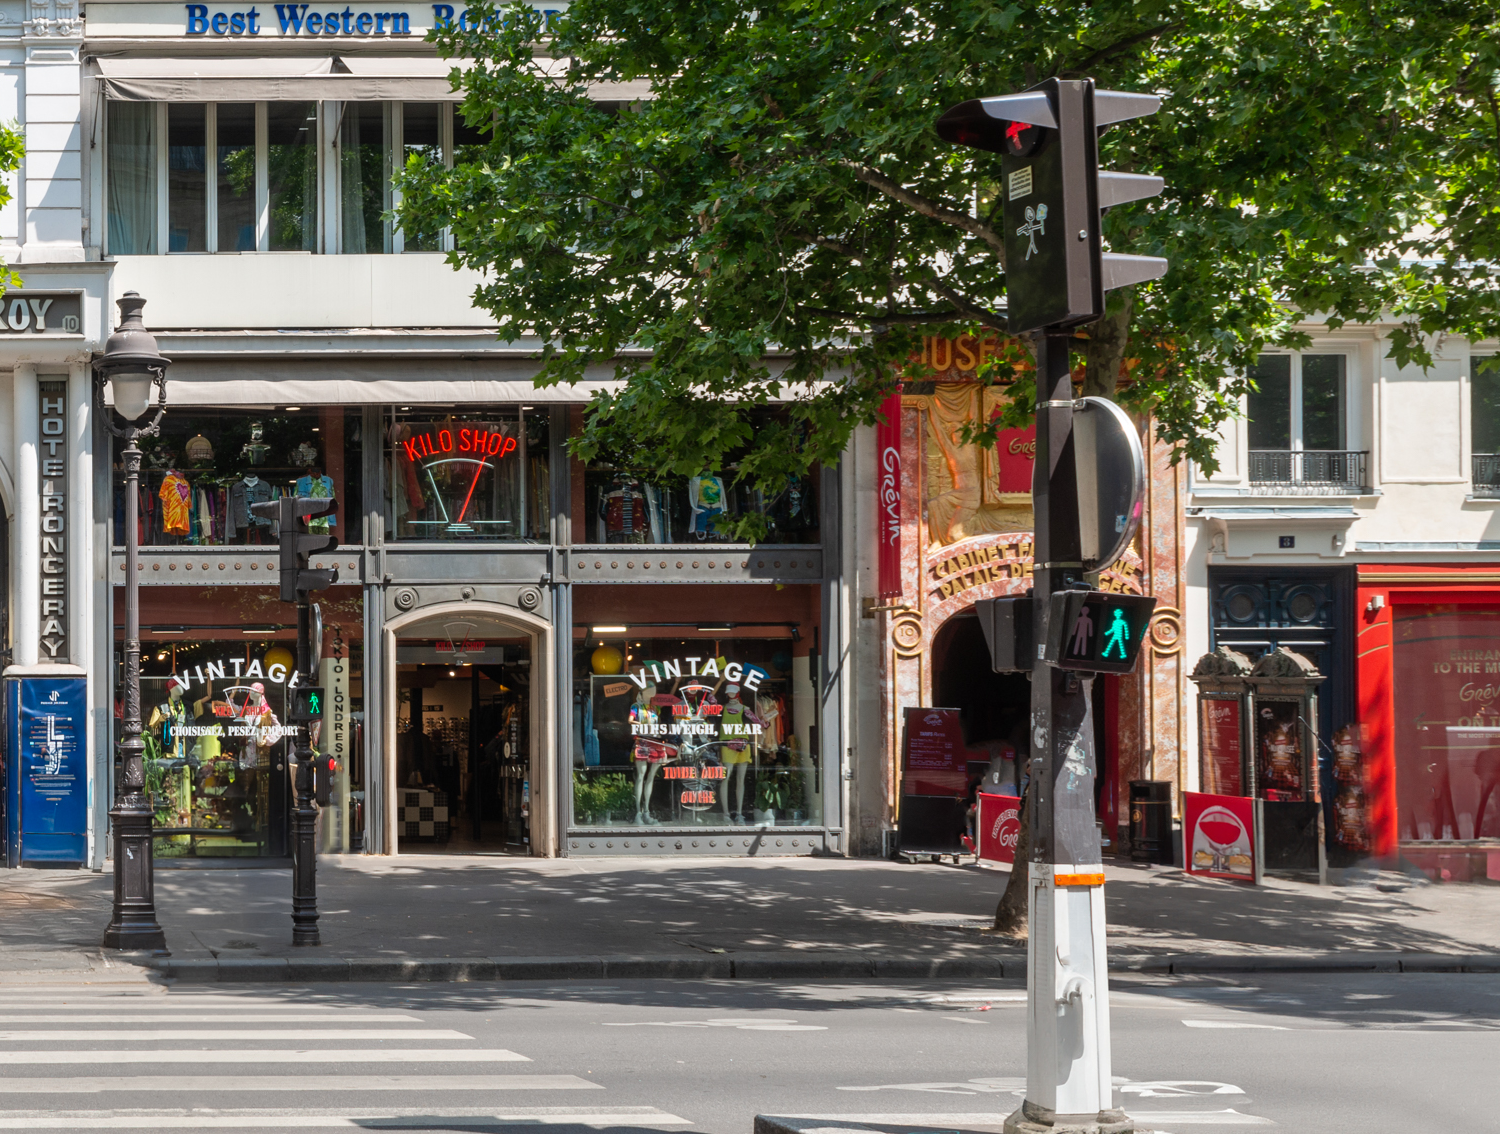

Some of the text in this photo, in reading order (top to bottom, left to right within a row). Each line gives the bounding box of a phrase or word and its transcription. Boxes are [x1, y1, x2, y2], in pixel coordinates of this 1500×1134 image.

[185, 4, 260, 35] Best
[274, 4, 412, 35] Western
[64, 317, 78, 331] 10
[41, 396, 65, 496] HOTEL
[403, 428, 517, 462] KILO SHOP
[1008, 435, 1037, 459] Gré
[935, 544, 1010, 578] CABINET
[41, 495, 66, 657] RONCERAY
[940, 562, 1035, 599] PALAIS DE
[900, 627, 914, 637] 10
[1158, 626, 1171, 635] 10
[333, 628, 344, 673] TOKYO
[435, 641, 485, 651] KILO SHOP
[1450, 649, 1500, 660] ENTRAN
[173, 657, 299, 691] VINTAGE
[628, 656, 765, 692] VINTAGE
[1433, 662, 1451, 673] TO
[1456, 662, 1480, 673] THE
[606, 684, 628, 694] ELECTRO
[1459, 682, 1500, 705] Grév
[215, 706, 265, 717] KILO SHOP
[334, 686, 344, 753] LONDRES
[672, 705, 723, 716] KILO SHOP
[228, 726, 259, 737] PESEZ,
[262, 726, 299, 737] EMPORT
[722, 724, 763, 735] WEAR
